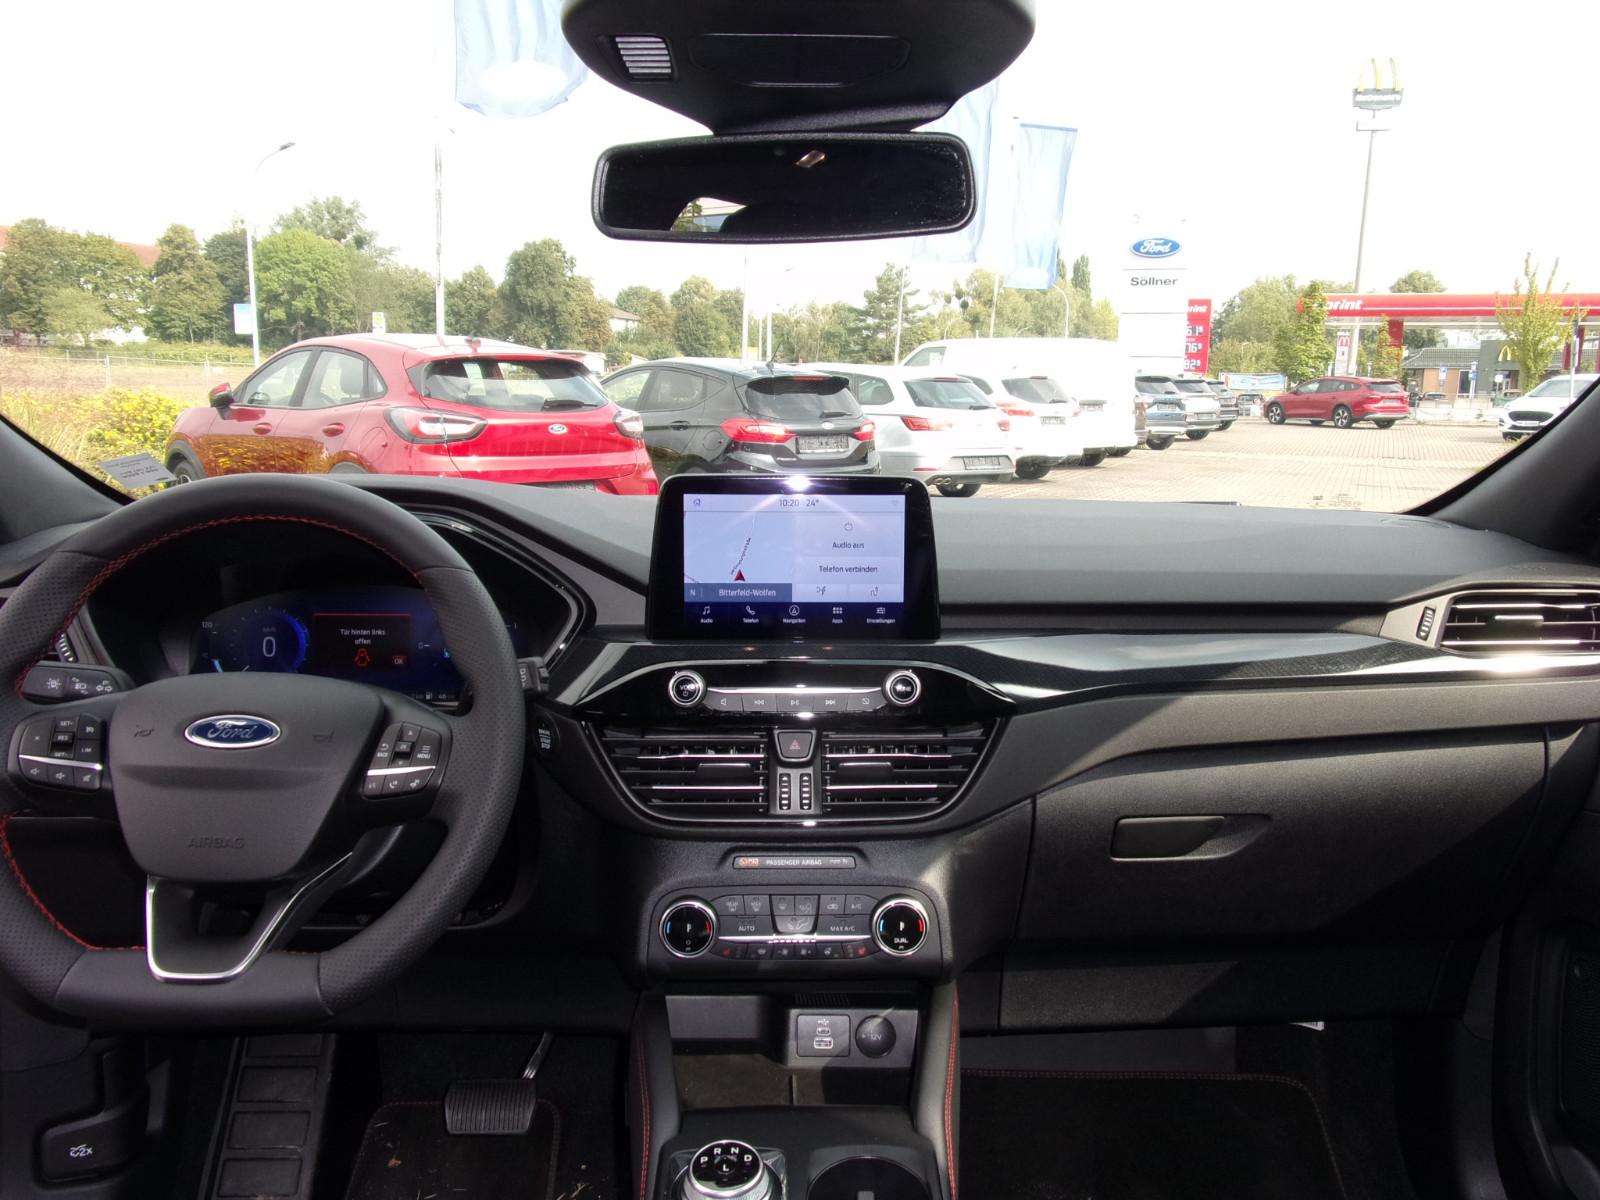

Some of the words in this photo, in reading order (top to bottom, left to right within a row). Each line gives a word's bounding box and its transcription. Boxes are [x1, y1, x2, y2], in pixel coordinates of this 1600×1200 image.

[1140, 239, 1172, 253] Ford
[1130, 276, 1178, 287] Söllner
[1326, 299, 1363, 311] print
[778, 499, 800, 508] 10:20
[832, 541, 850, 550] Audio
[818, 565, 843, 574] Telefon
[845, 565, 878, 574] verbinden
[690, 588, 697, 597] N
[718, 588, 777, 598] Bitterfeld-Wolfen
[831, 617, 843, 625] Apps
[340, 627, 350, 637] Tür
[351, 627, 371, 637] hinten
[371, 627, 386, 637] links
[354, 637, 371, 645] offen
[263, 636, 277, 657] 0
[207, 720, 255, 739] Ford
[188, 837, 246, 850] AIRBAG
[766, 858, 800, 866] PASSENGER
[801, 858, 822, 866] AIRBAG
[893, 936, 909, 944] DUAL
[714, 1147, 722, 1155] R
[700, 1156, 709, 1164] P
[744, 1154, 752, 1162] D
[722, 1163, 729, 1172] L
